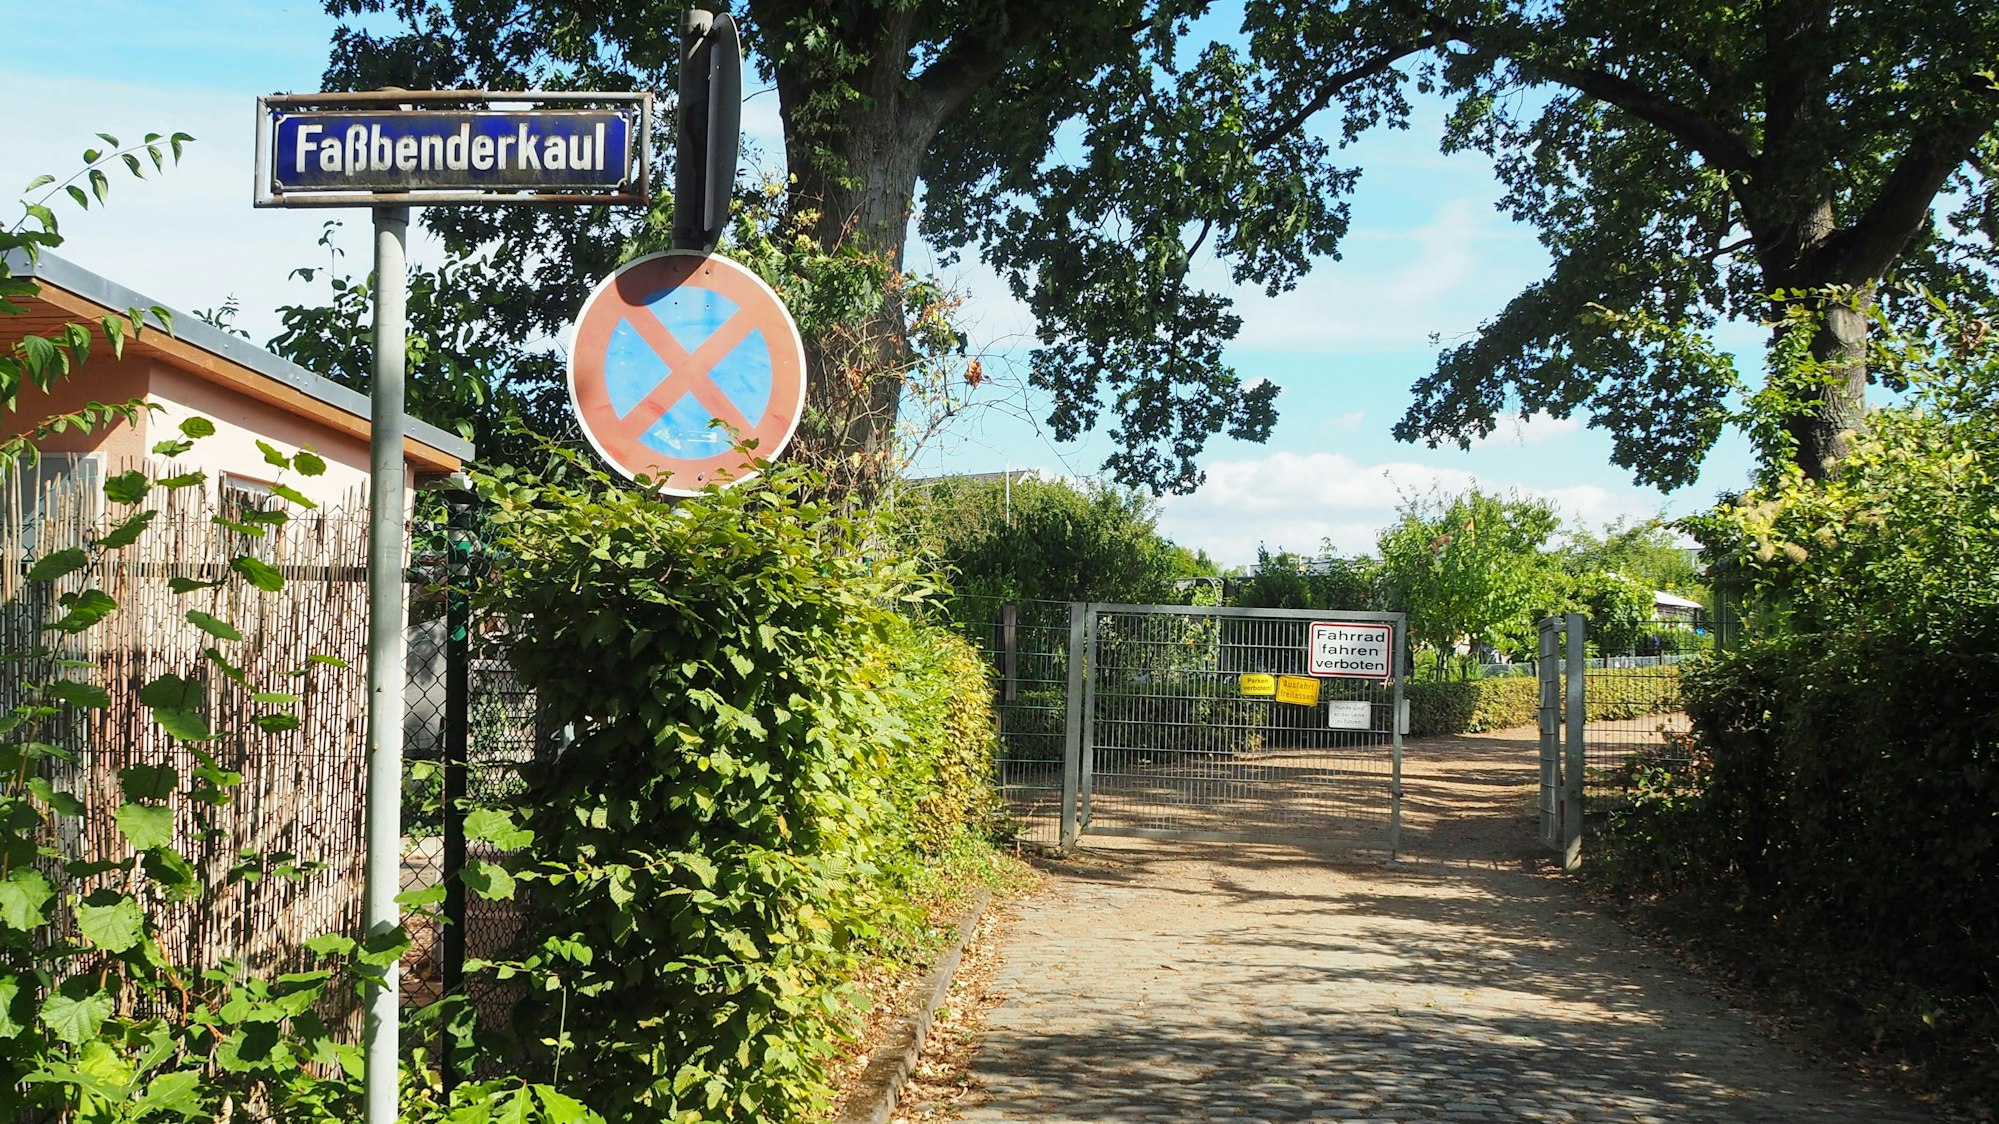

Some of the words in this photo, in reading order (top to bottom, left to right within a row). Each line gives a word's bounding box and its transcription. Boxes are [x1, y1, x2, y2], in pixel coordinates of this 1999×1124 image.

[296, 122, 605, 176] Faßbenderkaul
[1317, 629, 1385, 643] Fahrrad
[1322, 644, 1379, 656] fahren
[1316, 659, 1384, 671] verboten
[1283, 679, 1314, 690] Ausfahrt
[1280, 690, 1315, 700] freilassen
